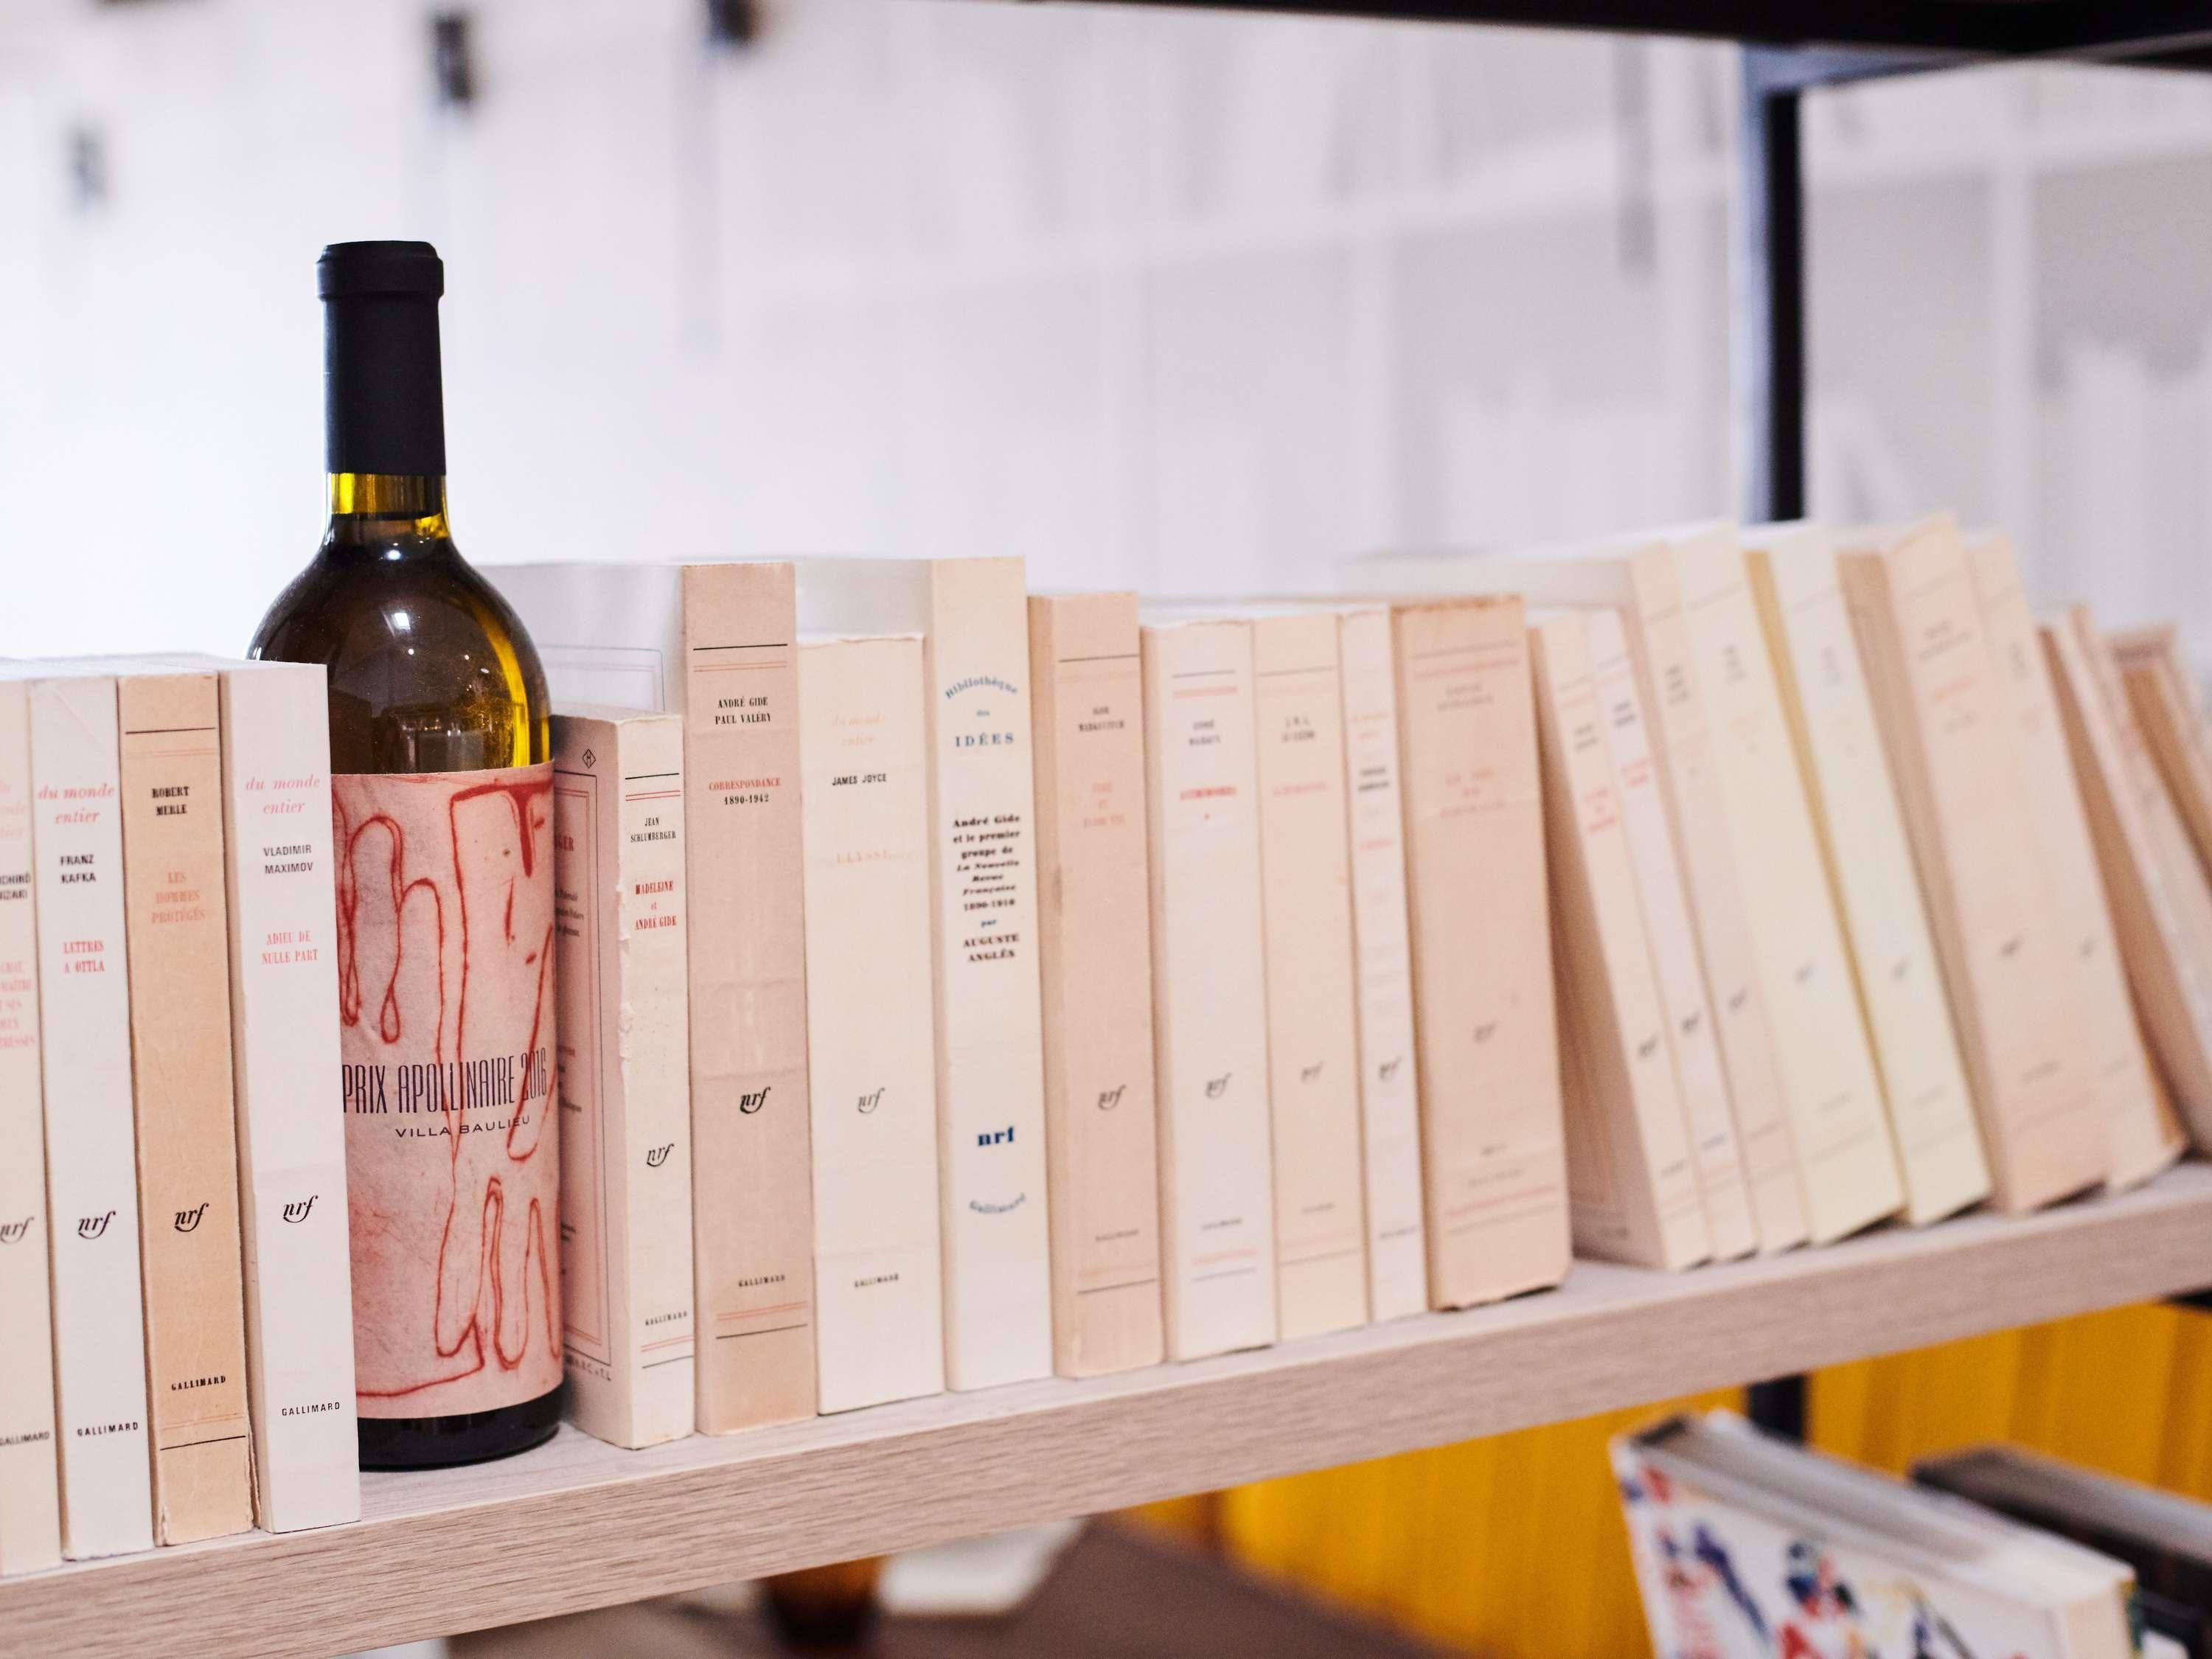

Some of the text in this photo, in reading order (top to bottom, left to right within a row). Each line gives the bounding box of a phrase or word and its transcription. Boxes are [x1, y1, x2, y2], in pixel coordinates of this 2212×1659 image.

[717, 696, 768, 709] ANDRÉ GIDE
[715, 711, 771, 725] PAUL VALÉRY
[955, 732, 1014, 748] IDÉES
[246, 774, 321, 792] du monde
[708, 777, 782, 791] CORRESPONDANCE
[832, 773, 887, 786] JAMES JOYCE
[38, 783, 115, 801] du monde
[152, 786, 190, 799] ROBERT
[724, 793, 769, 805] 1890-1942
[156, 804, 188, 815] MERLE
[262, 801, 305, 815] entier
[55, 807, 100, 825] entier
[644, 817, 660, 827] JEAN
[953, 814, 1020, 827] André Gide
[630, 830, 676, 844] SCHLUMBERGER
[979, 830, 1020, 843] premier
[262, 844, 312, 858] VLADIMIR
[961, 847, 995, 860] groupe
[60, 854, 95, 866] FRANZ
[264, 861, 313, 874] MAXIMOV
[60, 872, 97, 885] KAFKA
[167, 872, 187, 884] LES
[635, 881, 674, 896] MADELEINE
[155, 891, 201, 905] HOMMES
[659, 915, 677, 927] GIDE
[265, 931, 312, 946] ADIEU DE
[963, 933, 1020, 948] AUGUSTE
[63, 940, 105, 955] LETTRES
[261, 949, 319, 965] NULLE PART
[63, 960, 106, 974] A OTTLA
[342, 1047, 547, 1114] PRIX APOLLINAIRE 2016
[740, 1086, 771, 1114] nrf
[858, 1088, 886, 1113] nrf
[395, 1115, 530, 1138] VILLA BAULIEU
[646, 1143, 675, 1167] nrf
[283, 1195, 319, 1223] nrf
[77, 1210, 116, 1239] nrf
[174, 1203, 209, 1232] nrf
[171, 1375, 226, 1391] GALLIMARD
[281, 1402, 341, 1416] GALLIMARD
[77, 1422, 139, 1437] GALLIMARD
